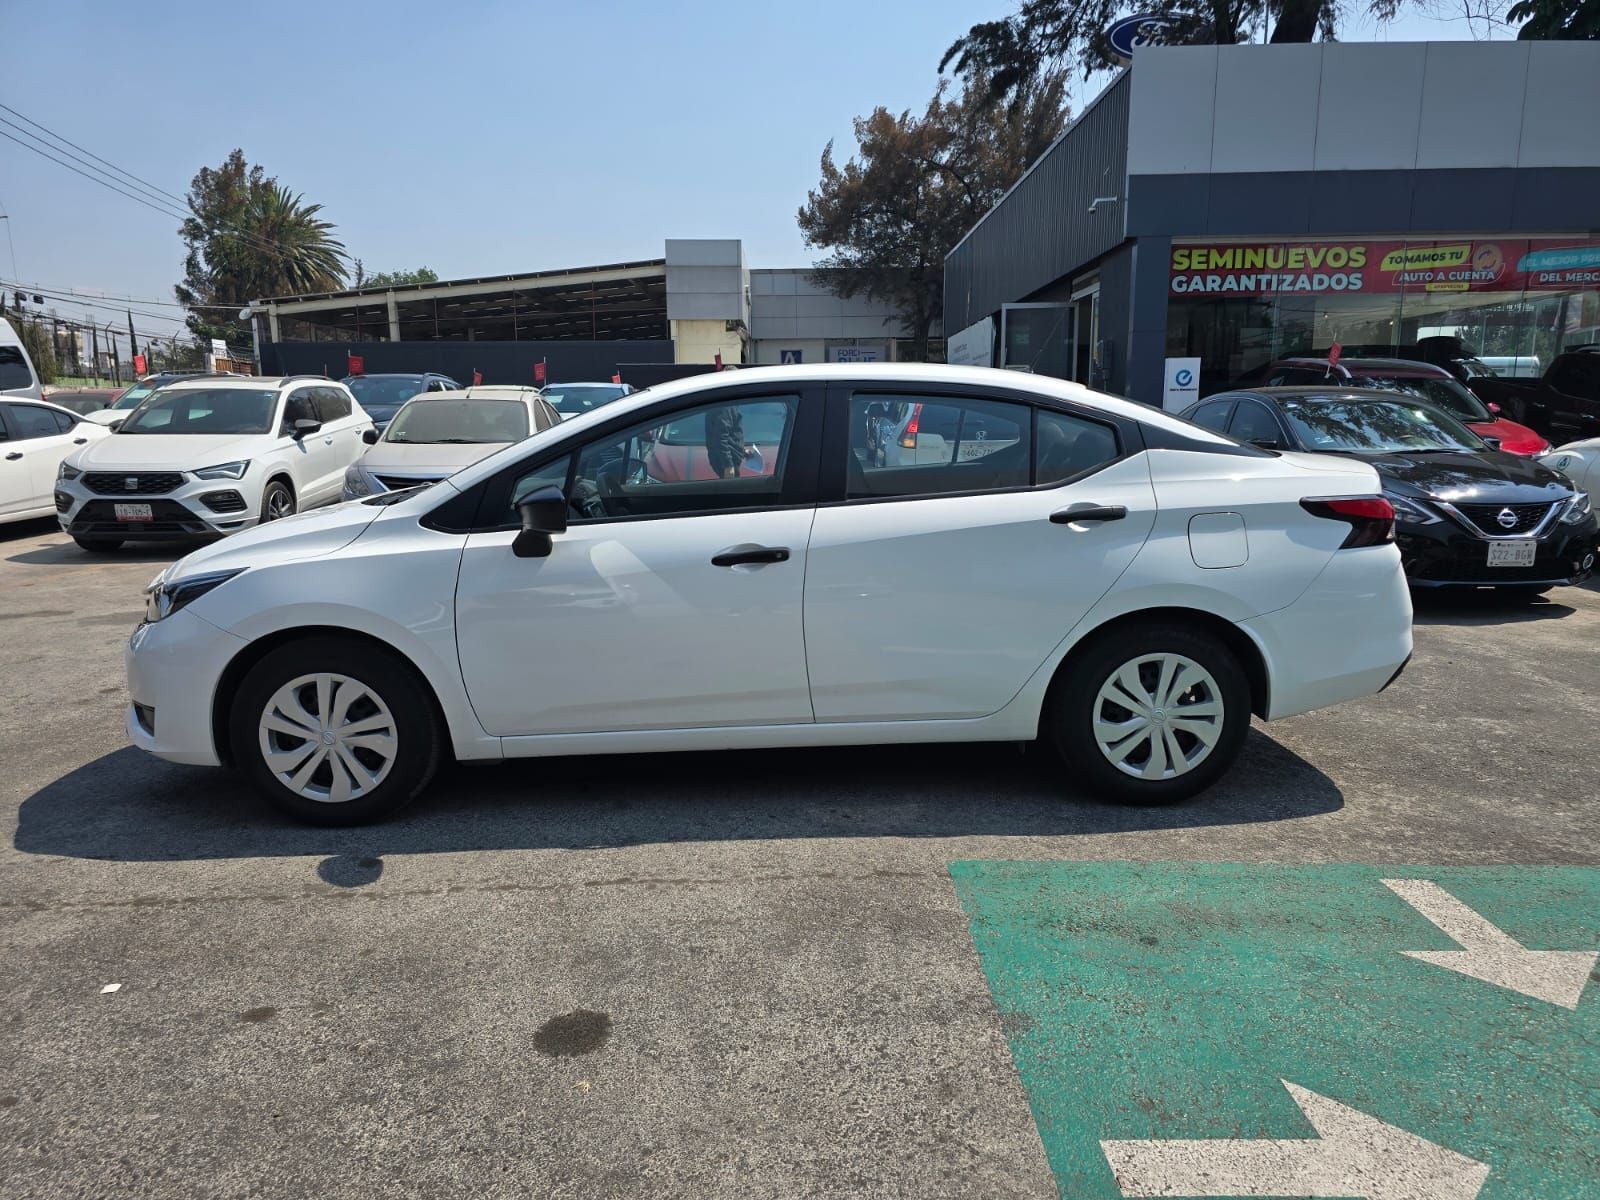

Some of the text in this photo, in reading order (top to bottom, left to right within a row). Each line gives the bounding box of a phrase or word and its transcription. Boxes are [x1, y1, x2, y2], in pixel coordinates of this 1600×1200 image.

[1173, 247, 1366, 270] SEMINUEVOS
[1389, 250, 1464, 264] TOMAMOS TU
[1172, 273, 1362, 292] GARANTIZADOS
[1399, 271, 1496, 282] AUTO A CUENTA
[1540, 273, 1562, 282] DEL
